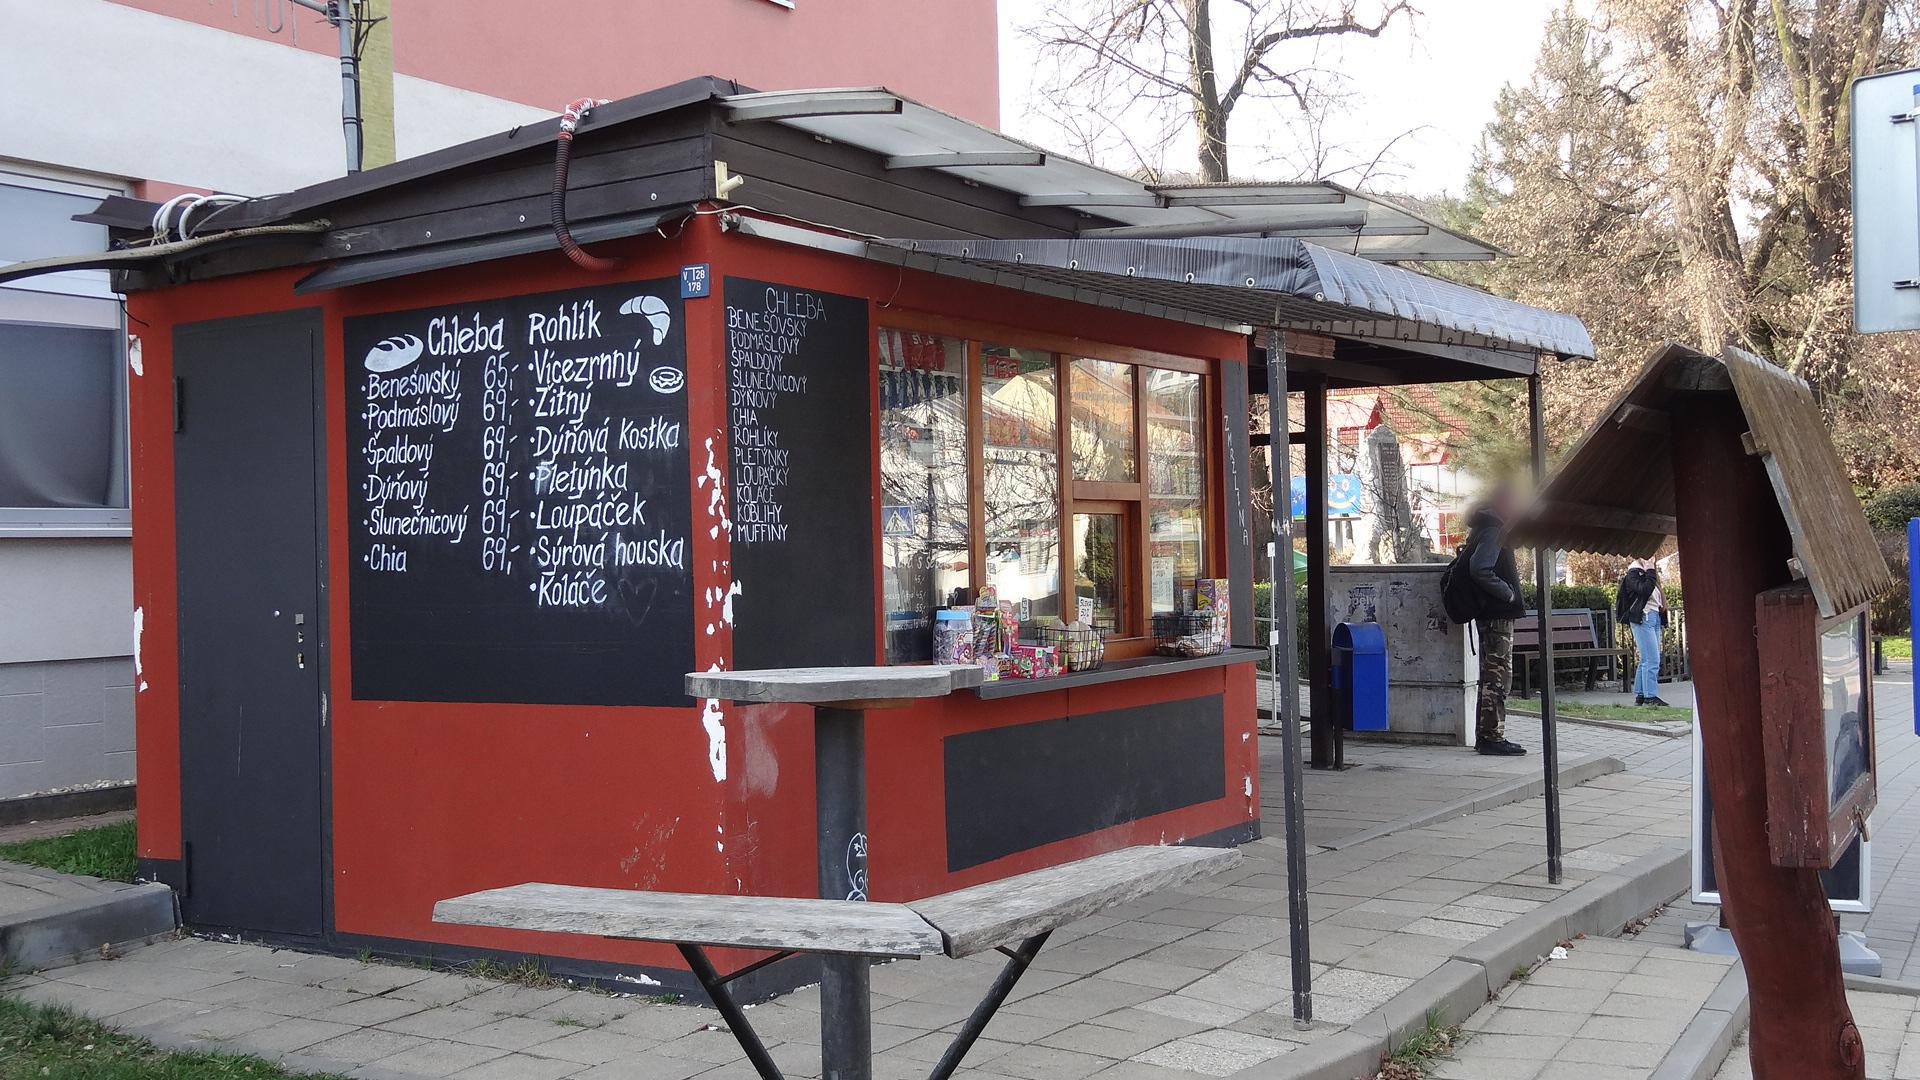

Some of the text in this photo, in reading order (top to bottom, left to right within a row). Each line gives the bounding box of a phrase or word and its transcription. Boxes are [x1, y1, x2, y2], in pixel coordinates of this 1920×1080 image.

[529, 299, 601, 345] Rohlík
[766, 287, 827, 321] CHLEBA
[428, 311, 504, 356] Chleba
[367, 358, 461, 400] Benešovský
[534, 339, 641, 387] Vícezrnný
[367, 393, 461, 432] Podmáslový
[535, 381, 593, 424] Žitný
[733, 407, 759, 426] CHIA
[367, 430, 433, 474] Špaldový
[533, 417, 610, 465] Dýňová
[733, 425, 779, 448] ROHLÍKY
[734, 446, 789, 467] PLETÝNKY
[736, 465, 790, 486] LOUPÁČKY
[366, 470, 429, 509] Dýňový
[536, 456, 628, 500] Pletýnka
[736, 485, 777, 504] KOLÁČE
[369, 505, 469, 544] Slunečnicový
[536, 491, 646, 546] Loupáček
[737, 503, 783, 523] KOBLIHY
[538, 529, 684, 575] Sýrová houska
[737, 524, 789, 543] MUFFINY
[370, 544, 407, 572] Chia
[538, 568, 608, 607] Koláče
